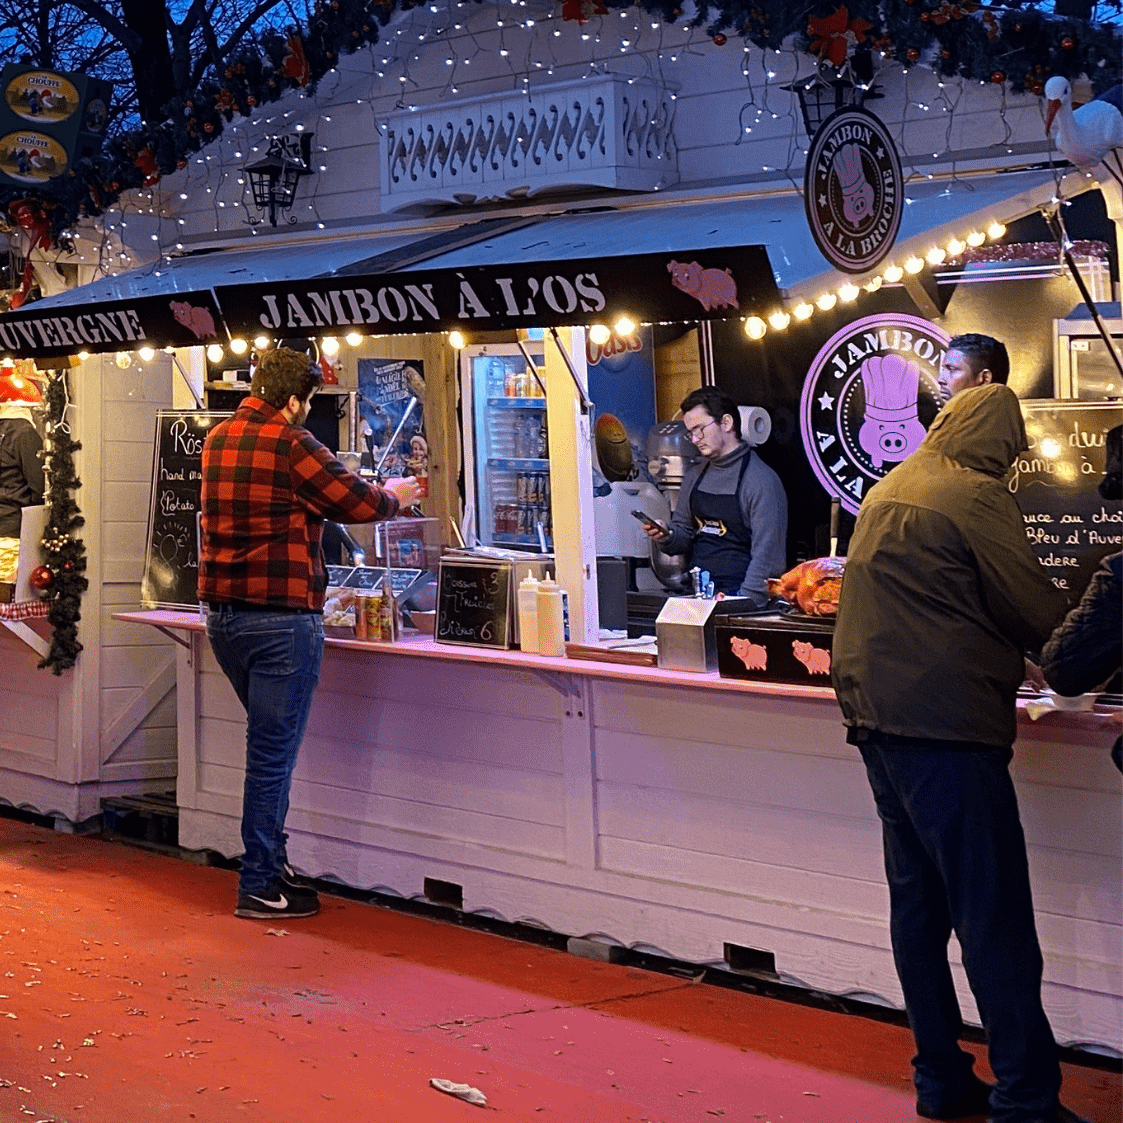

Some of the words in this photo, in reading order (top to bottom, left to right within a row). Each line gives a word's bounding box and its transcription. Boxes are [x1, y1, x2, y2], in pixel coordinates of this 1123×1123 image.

[28, 77, 61, 88] CHOUFFE
[16, 136, 50, 148] CHOUFFE
[817, 124, 874, 181] JAMBON
[823, 221, 836, 238] A
[836, 233, 857, 257] LA
[859, 168, 895, 256] BROCHE
[259, 282, 441, 329] JAMBON
[455, 272, 491, 319] À
[495, 272, 607, 317] L'OS
[1080, 455, 1097, 475] à
[829, 455, 865, 500] LA
[1059, 514, 1084, 524] au
[1091, 506, 1123, 524] choi
[480, 620, 494, 641] 6
